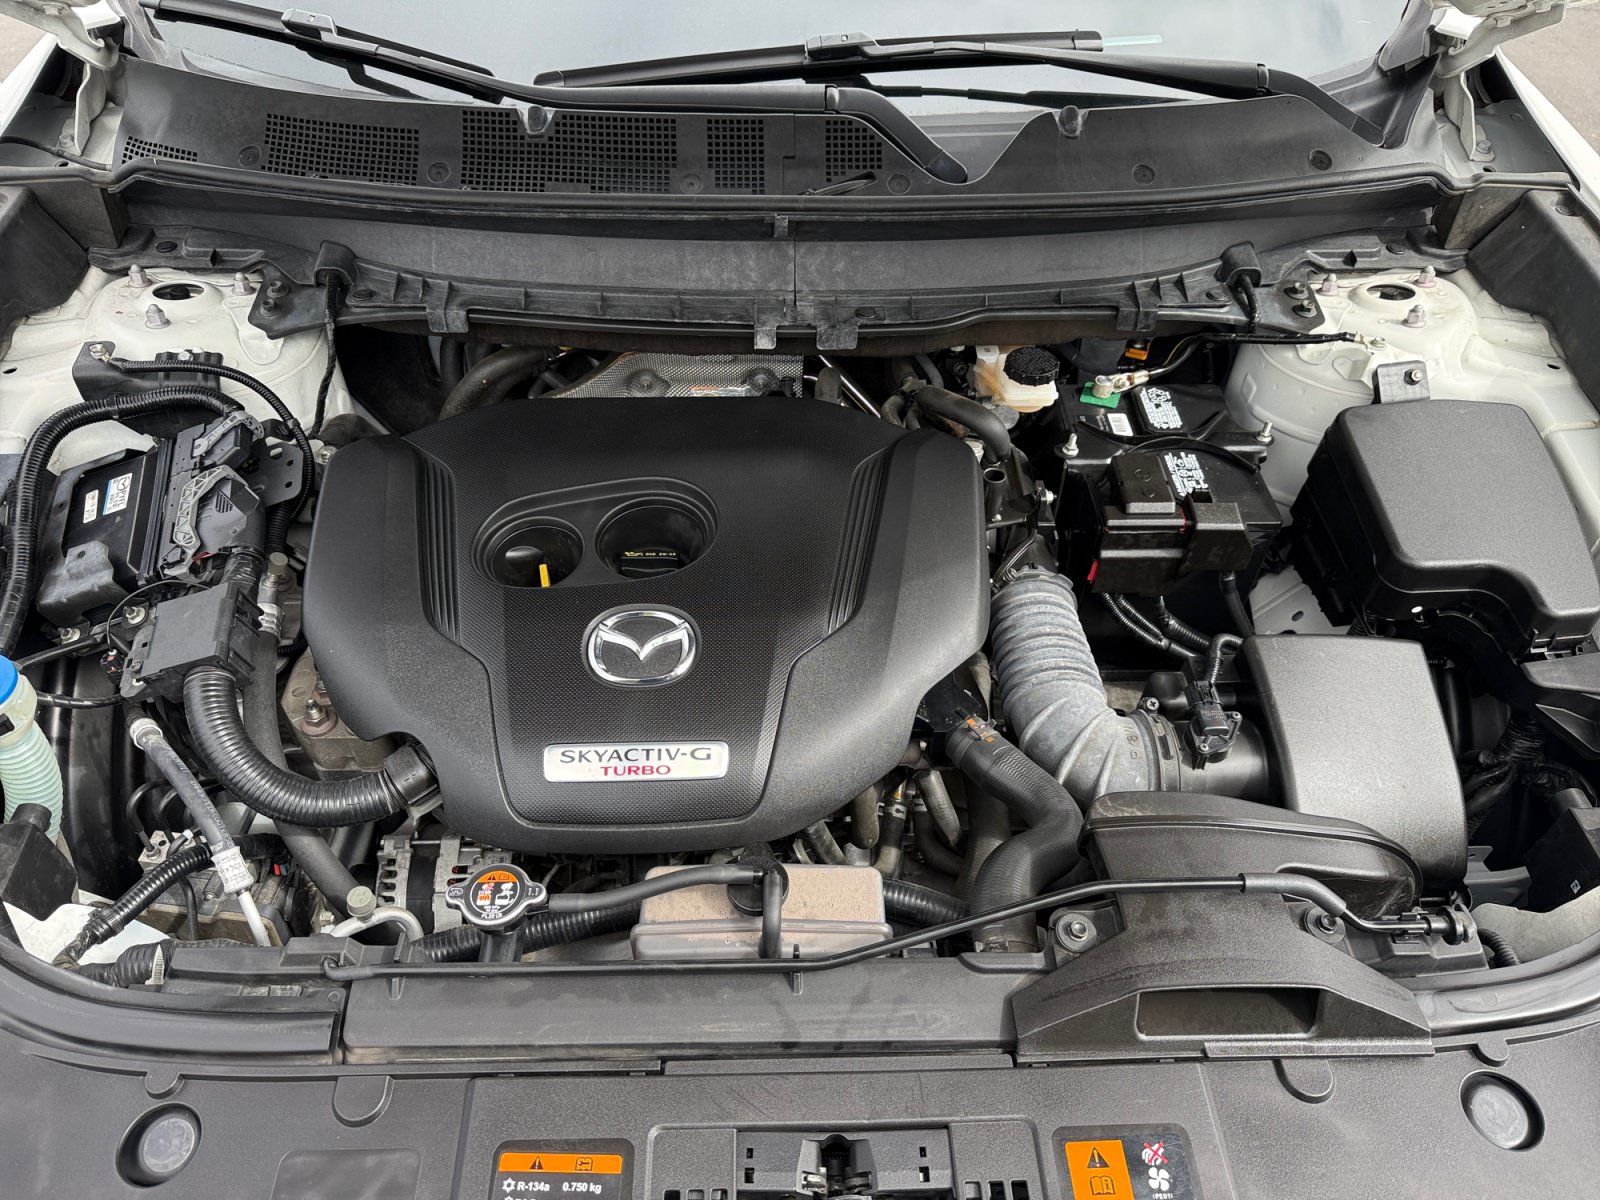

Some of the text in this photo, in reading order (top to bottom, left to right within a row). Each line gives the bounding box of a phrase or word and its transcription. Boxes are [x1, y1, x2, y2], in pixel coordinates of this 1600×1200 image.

[560, 747, 711, 764] SKYACTIV-G
[600, 764, 671, 776] TURBO
[516, 1181, 602, 1194] R-134a 0.750 kg
